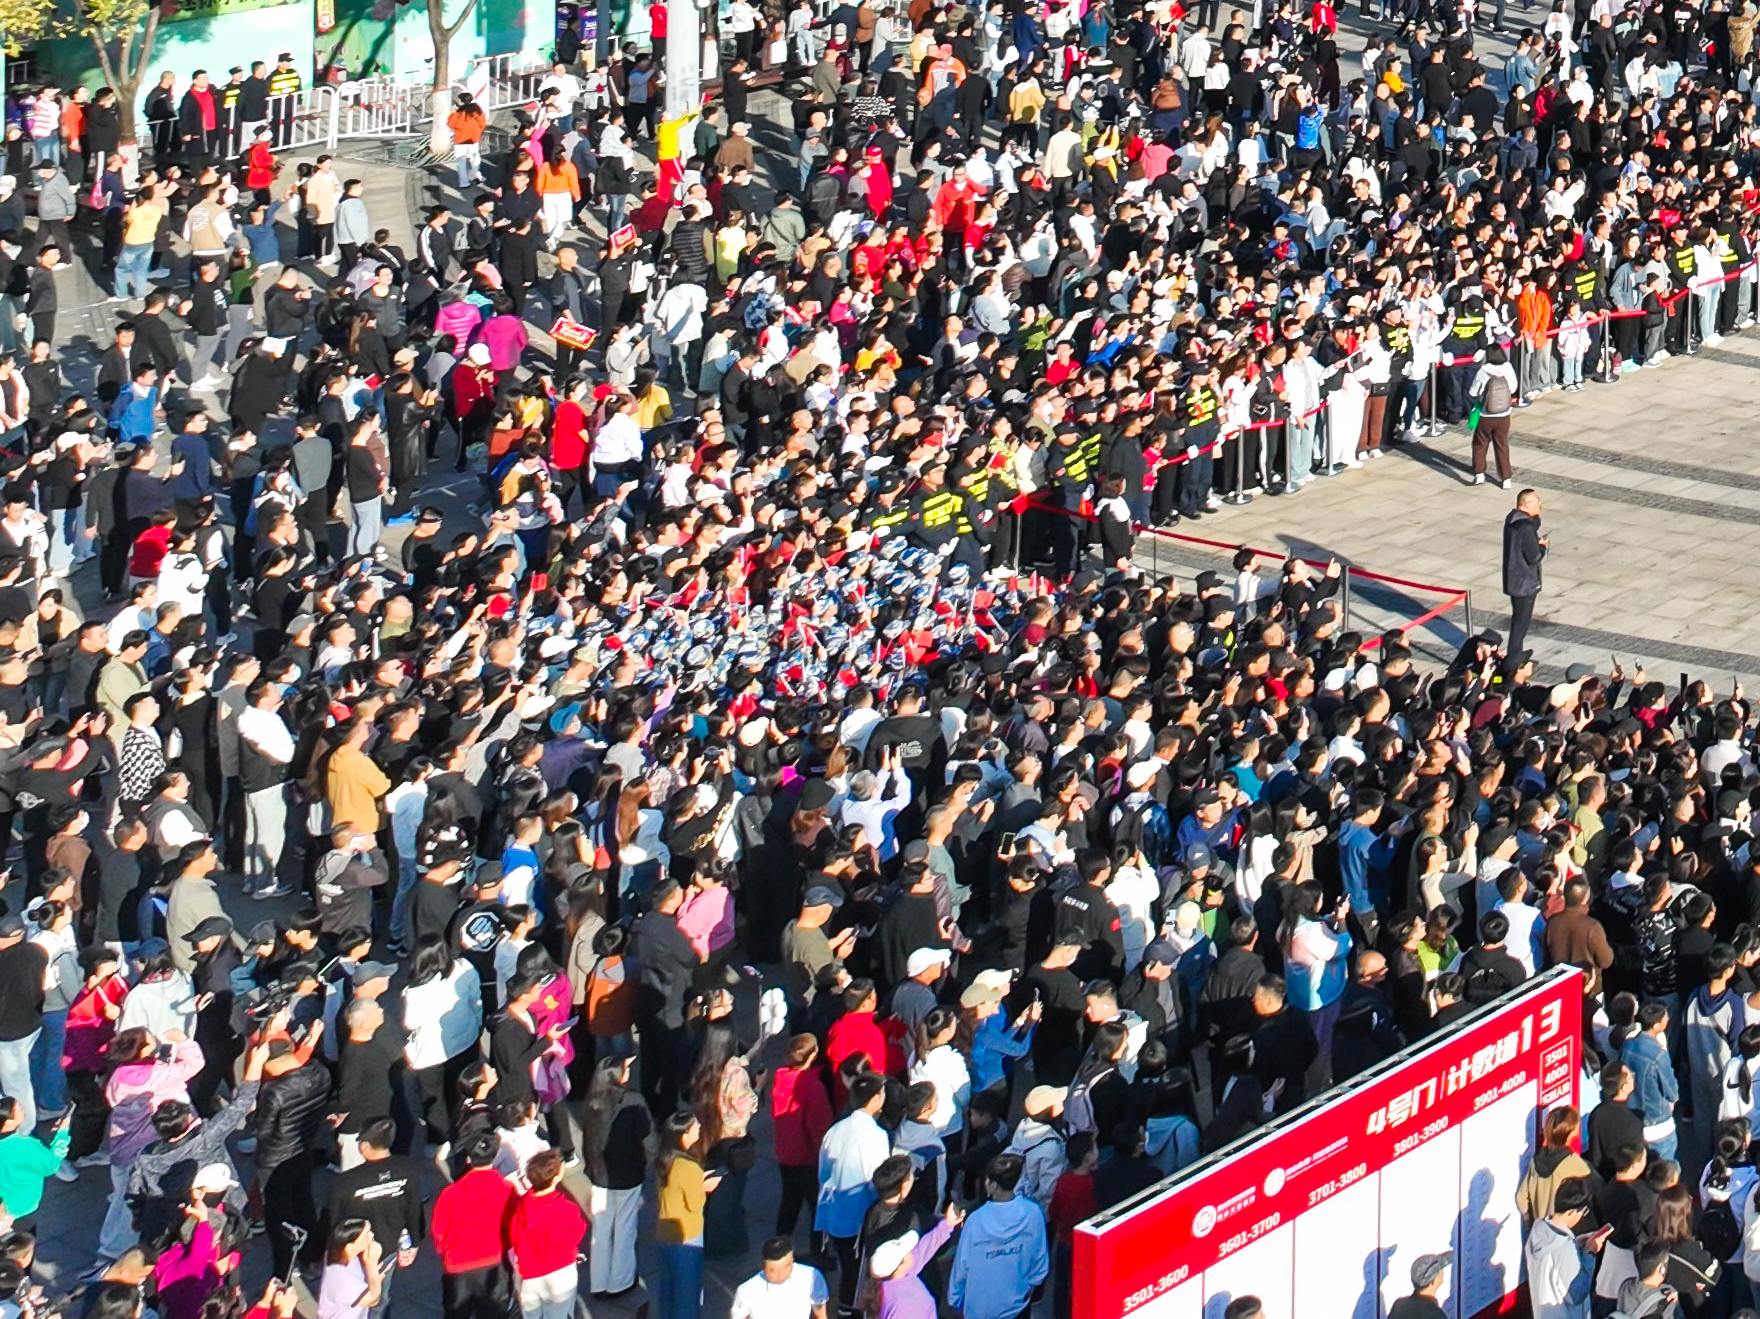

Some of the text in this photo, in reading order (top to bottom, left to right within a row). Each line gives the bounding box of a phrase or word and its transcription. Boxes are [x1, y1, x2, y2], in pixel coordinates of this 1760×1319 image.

[1544, 1063, 1569, 1084] 4000
[1545, 1045, 1568, 1068] 3501
[1473, 1071, 1527, 1111] 3901-4000
[1393, 1115, 1449, 1157] 3801-3900
[1308, 1162, 1367, 1206] 3701-3800
[1218, 1212, 1281, 1257] 3601-3700
[1123, 1264, 1189, 1312] 3501-3600
